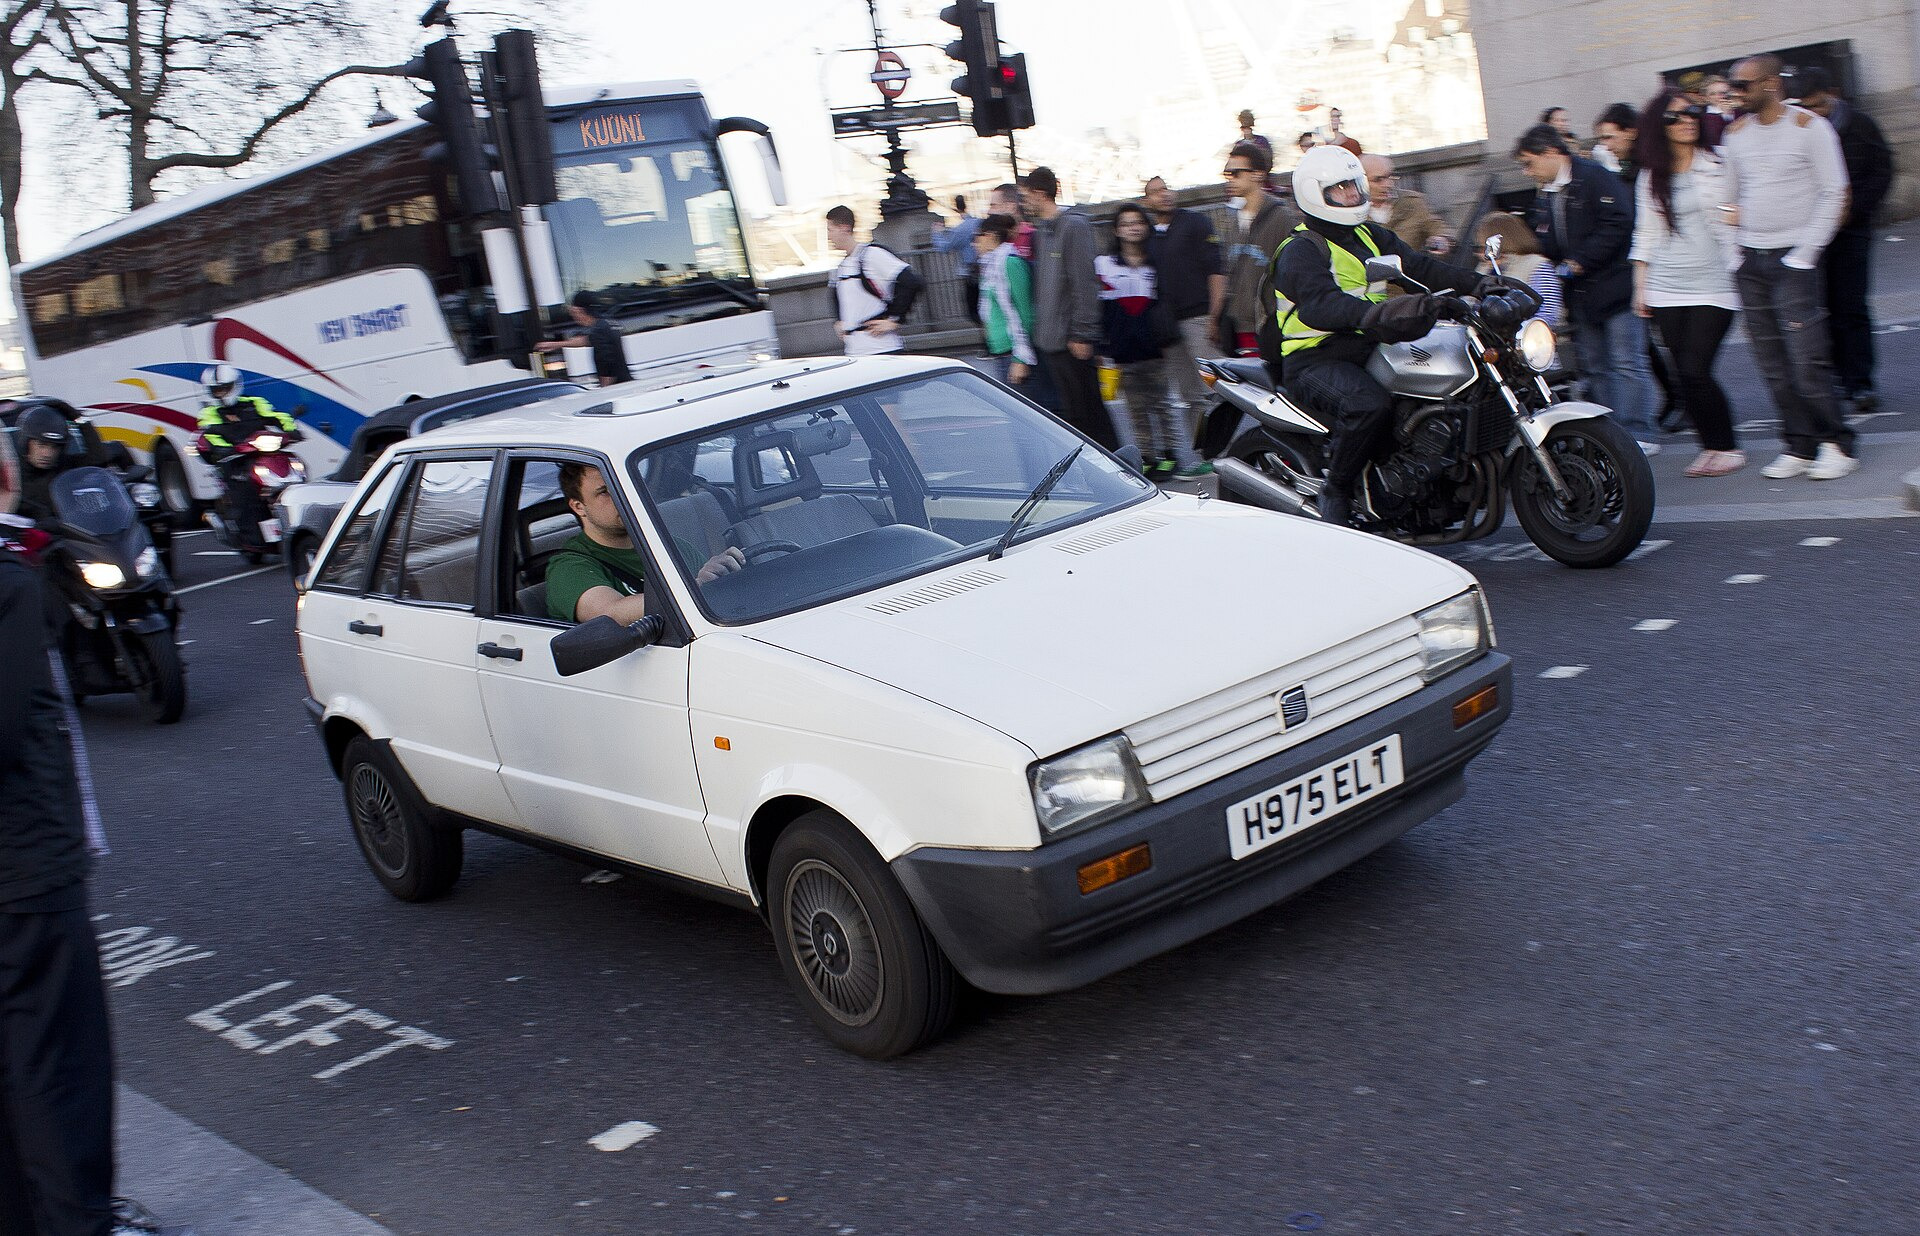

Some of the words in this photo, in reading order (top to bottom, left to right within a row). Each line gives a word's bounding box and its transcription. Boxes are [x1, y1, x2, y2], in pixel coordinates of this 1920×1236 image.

[580, 113, 646, 148] KUONI
[1242, 775, 1325, 846] H975
[1332, 744, 1388, 805] ELT
[184, 979, 456, 1079] LEFT
